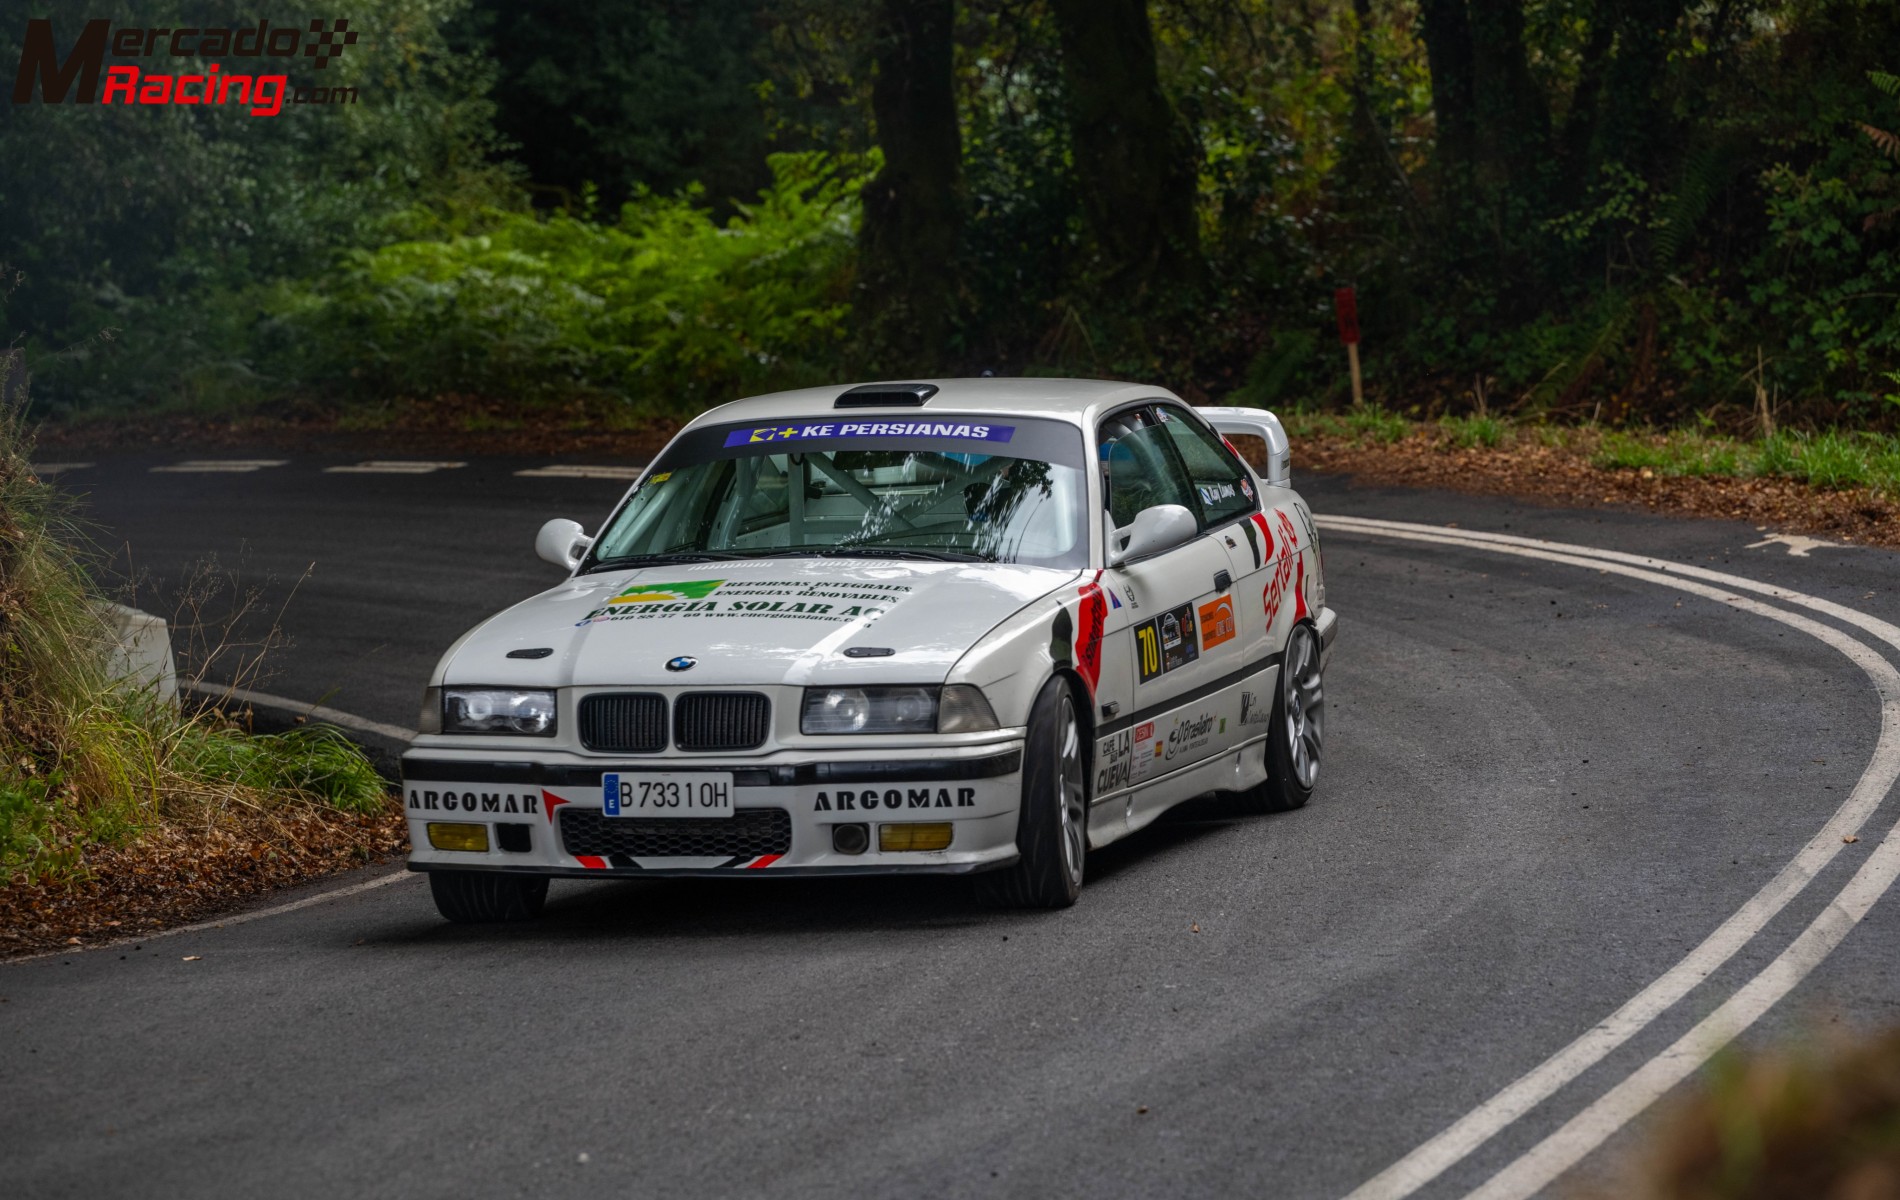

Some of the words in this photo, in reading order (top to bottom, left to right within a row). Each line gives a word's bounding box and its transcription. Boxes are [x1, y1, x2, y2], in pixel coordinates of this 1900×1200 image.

[801, 425, 832, 437] KE
[839, 423, 990, 438] PERSIANAS
[814, 582, 912, 593] INTEGRALES
[796, 590, 900, 604] RENOVABLES
[728, 601, 834, 614] SOLAR
[1138, 626, 1158, 677] 70
[1118, 730, 1130, 758] LA
[1097, 761, 1128, 794] CUEVA
